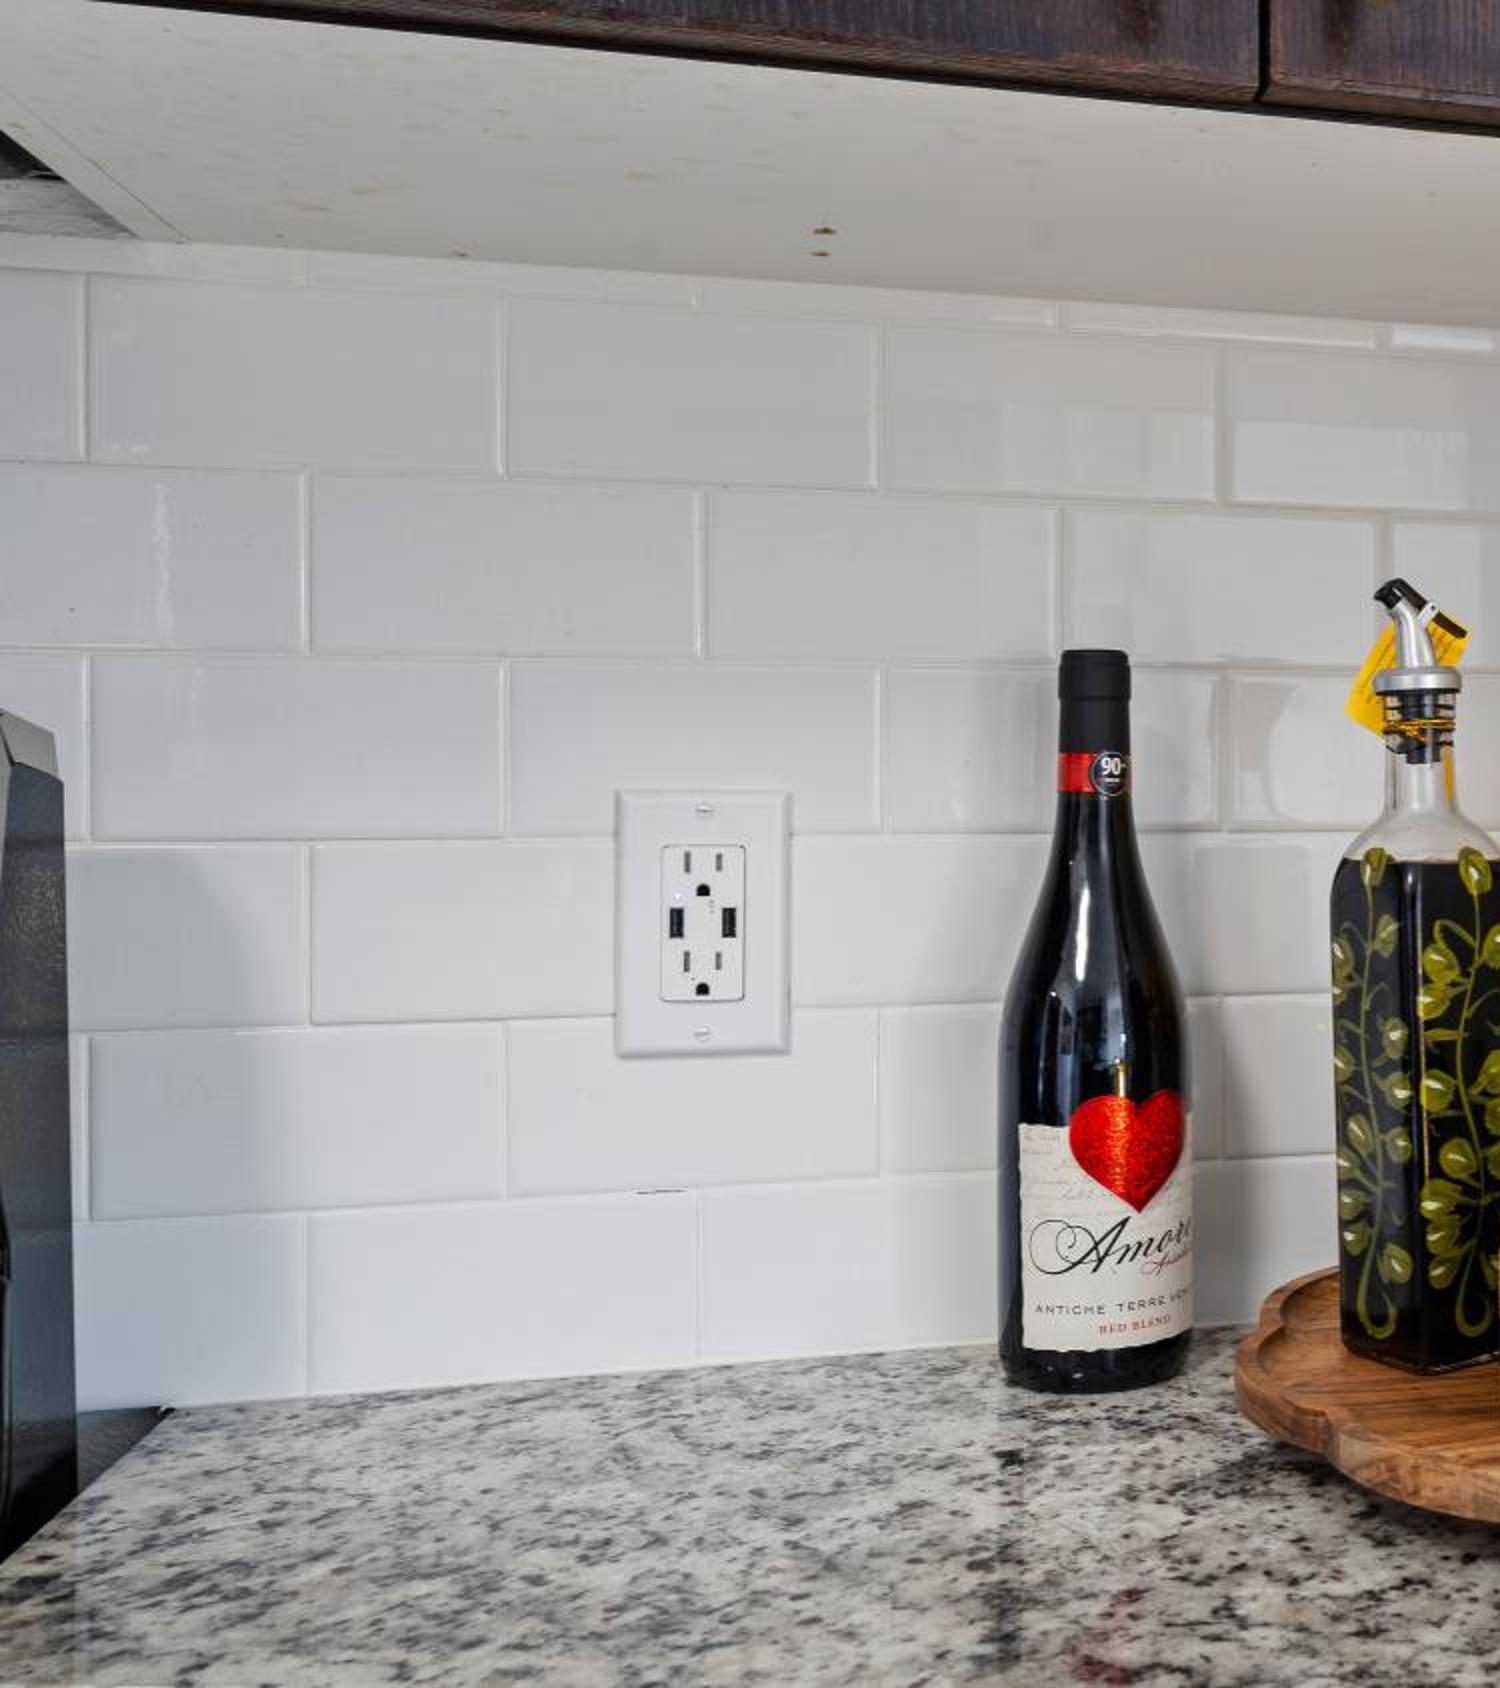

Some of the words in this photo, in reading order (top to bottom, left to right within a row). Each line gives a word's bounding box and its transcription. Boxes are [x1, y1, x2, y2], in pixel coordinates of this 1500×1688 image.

[1035, 1304, 1105, 1315] ANTICHE
[1116, 1296, 1166, 1313] TERRE
[1099, 1323, 1127, 1335] RED
